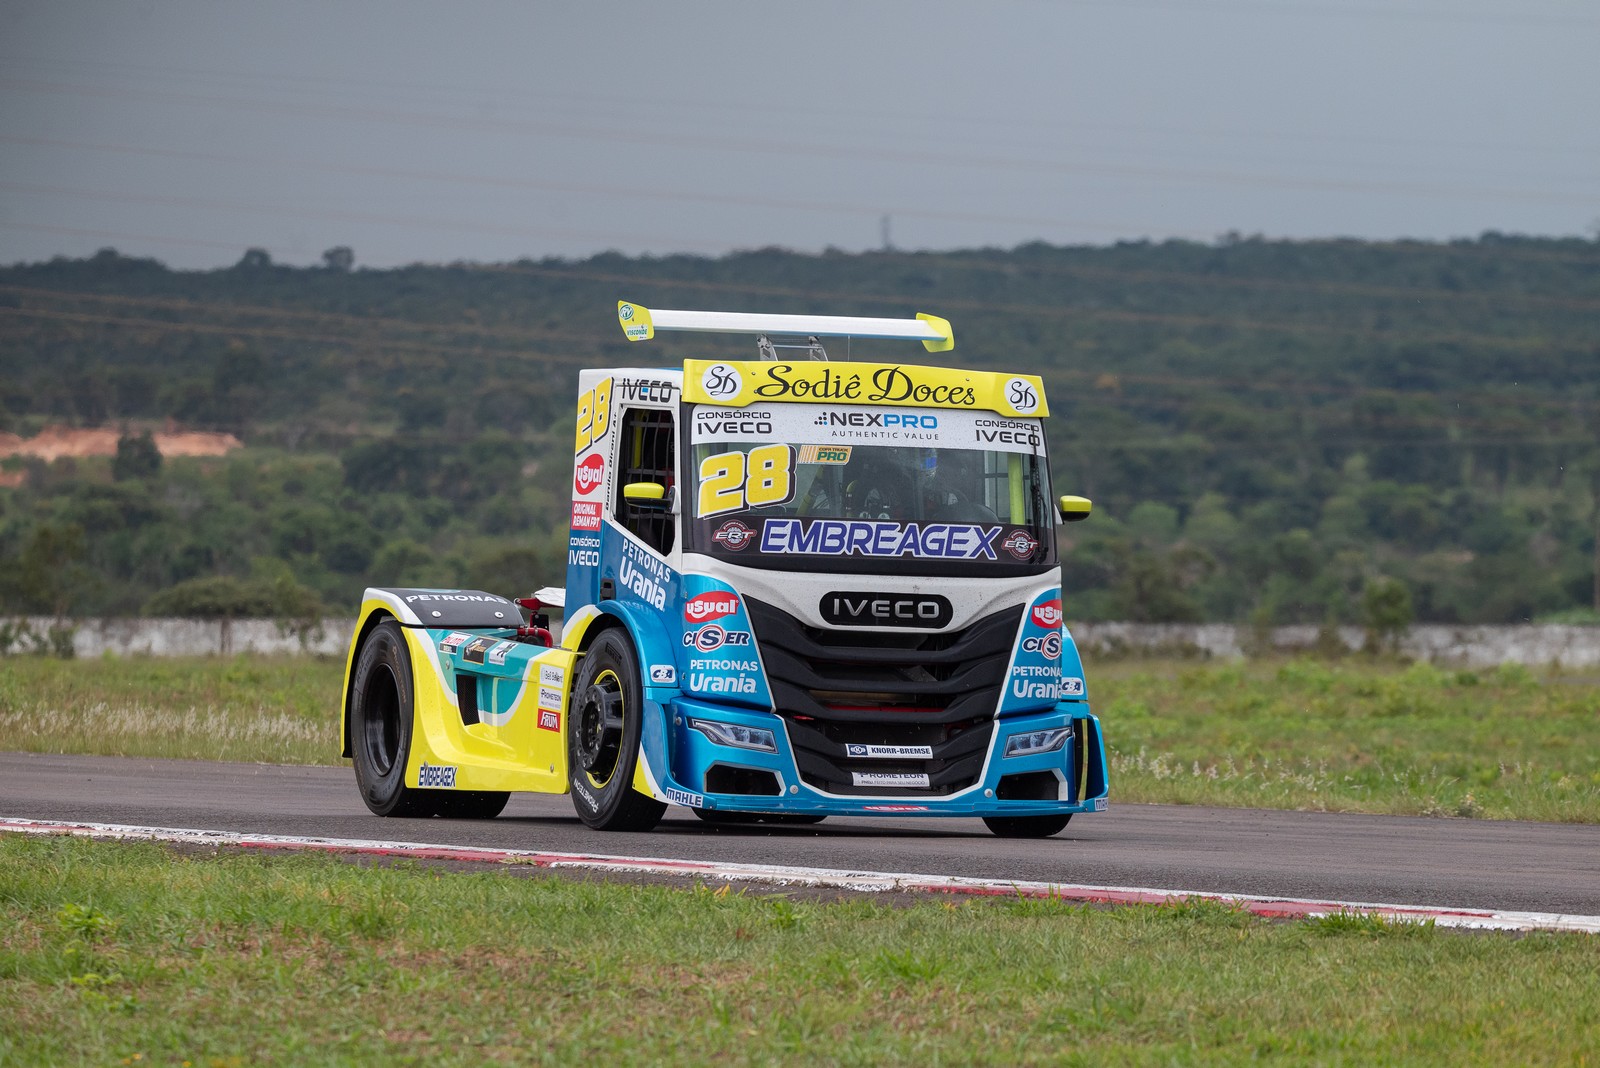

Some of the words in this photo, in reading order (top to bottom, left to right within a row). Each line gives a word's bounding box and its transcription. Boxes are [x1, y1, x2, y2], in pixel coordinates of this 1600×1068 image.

[622, 378, 672, 402] IVECO
[756, 365, 861, 399] Sodiê
[868, 366, 976, 405] Doces
[576, 377, 615, 457] 28
[697, 410, 771, 420] CONSÓRCIO
[830, 412, 938, 429] NEXPRO
[697, 421, 773, 434] IVECO
[975, 419, 1039, 432] CONSÓRCIO
[831, 430, 898, 439] AUTHENTIC
[904, 432, 939, 441] VALUE
[976, 429, 1041, 447] IVECO
[817, 452, 847, 461] PRO
[577, 465, 603, 489] usual
[698, 443, 797, 520] 28
[574, 503, 596, 515] ORIGINAL
[573, 516, 590, 527] REMAN
[570, 536, 600, 548] CONSÓRCIO
[760, 519, 1002, 560] EMBREAGEX
[568, 549, 599, 567] IVECO
[622, 538, 671, 583] PETRONAS
[620, 555, 667, 612] Urania
[405, 594, 508, 605] PETRONAS
[686, 599, 736, 618] usual
[833, 598, 940, 618] IVECO
[1034, 606, 1062, 625] usu
[683, 627, 750, 648] CISER
[1022, 637, 1061, 655] CIS
[652, 669, 674, 679] CBA
[690, 659, 758, 671] PETRONAS
[1013, 666, 1062, 677] PETRONA
[690, 673, 757, 693] Urania
[871, 747, 931, 755] KNORR-BREMSE
[418, 765, 457, 788] EMBREAGEX
[666, 788, 702, 807] MAHLE
